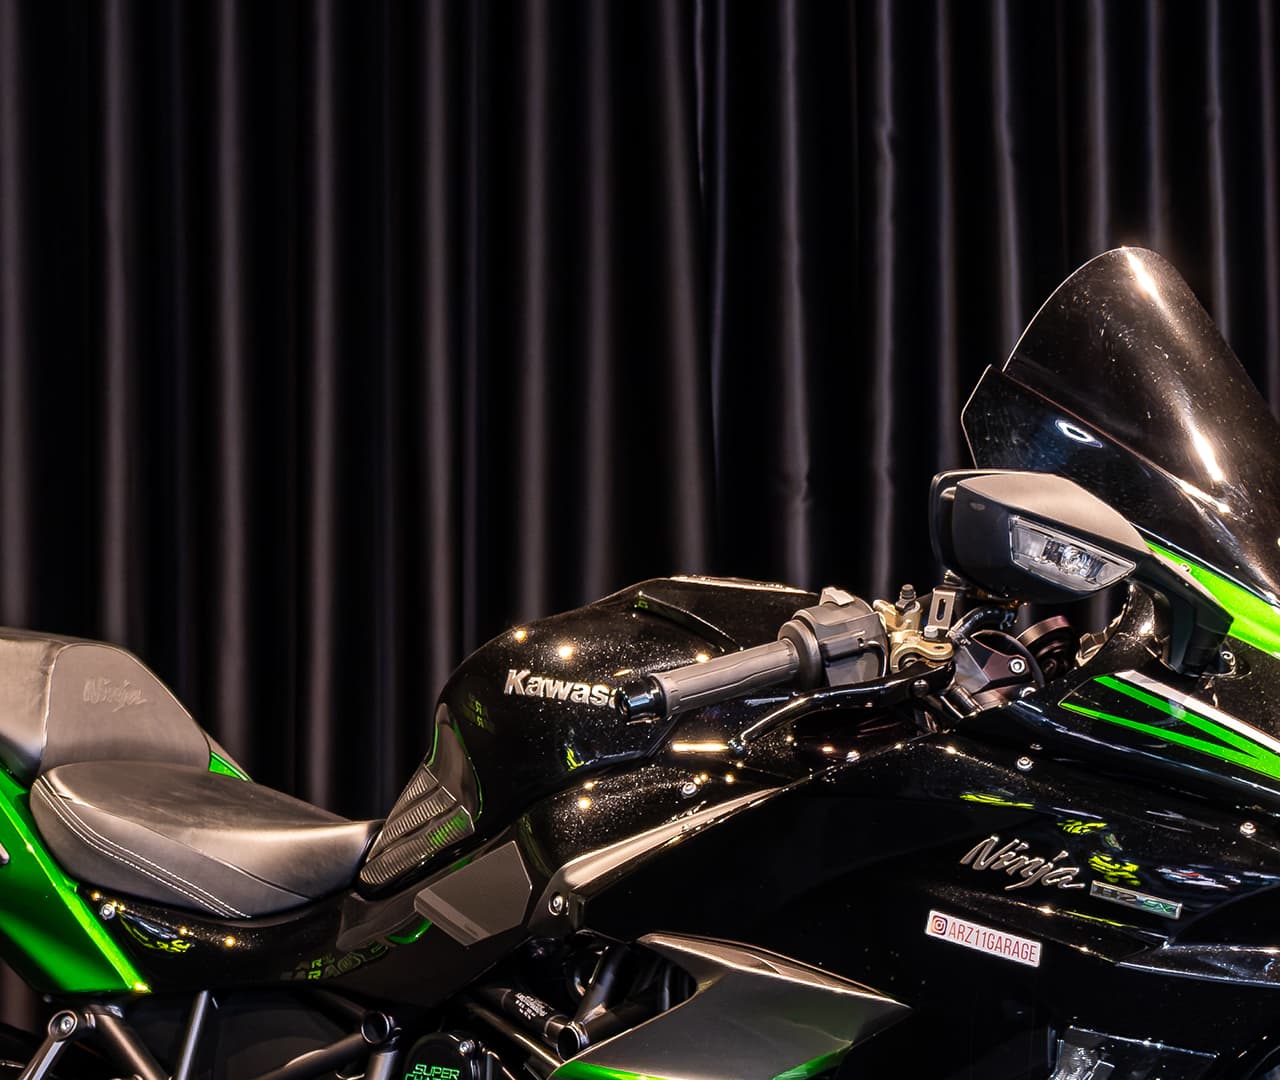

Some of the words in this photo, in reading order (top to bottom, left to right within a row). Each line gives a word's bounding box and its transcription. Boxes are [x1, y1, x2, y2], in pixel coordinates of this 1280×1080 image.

[503, 668, 617, 709] Kawas
[959, 834, 1086, 892] Ninja
[948, 921, 1037, 963] ARZ11GARAGE
[412, 1063, 460, 1080] SUPER
